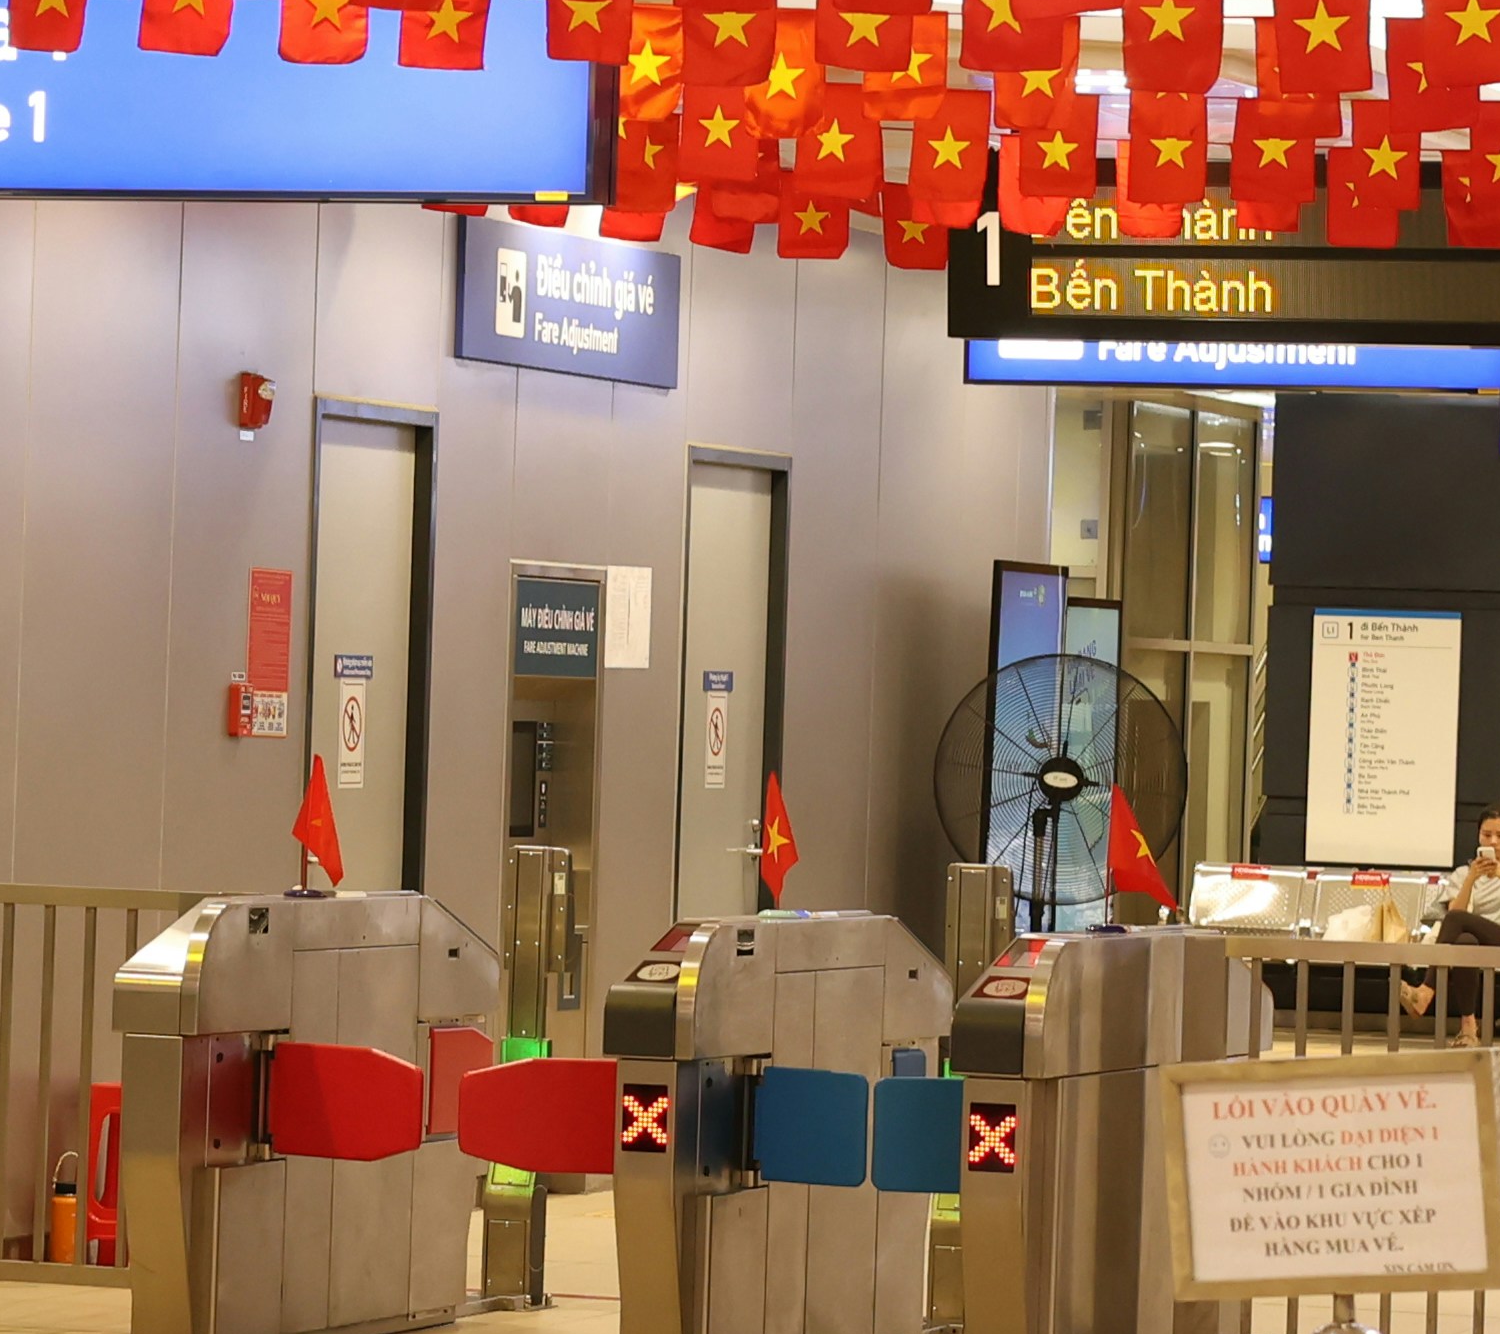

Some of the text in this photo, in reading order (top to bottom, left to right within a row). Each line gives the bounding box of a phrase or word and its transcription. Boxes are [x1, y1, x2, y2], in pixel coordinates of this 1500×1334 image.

[28, 90, 46, 142] 1
[976, 211, 1000, 286] 1
[536, 253, 654, 320] Điều chỉnh giá vé
[1030, 259, 1117, 310] Bến
[1135, 270, 1272, 312] Thành
[534, 312, 619, 355] Fare Adjustment
[1262, 1091, 1315, 1117] VÀO
[1398, 1084, 1436, 1110] VÉ.
[1241, 1133, 1275, 1150] VUI
[1281, 1130, 1335, 1148] LÒNG
[1379, 1126, 1425, 1145] DIỆN
[1431, 1126, 1439, 1141] 1
[1232, 1153, 1423, 1177] HÀNH KHÁCH CHO 1
[1243, 1183, 1301, 1203] NHÓM
[1317, 1184, 1325, 1199] 1
[1331, 1182, 1365, 1198] GIA
[1370, 1178, 1418, 1197] ĐÌNH
[1260, 1211, 1300, 1231] VÀO
[1306, 1212, 1348, 1229] KHU
[1352, 1208, 1394, 1233] VỰC
[1399, 1206, 1436, 1225] XẾP
[1264, 1233, 1404, 1257] HÀNG MUA VÉ.
